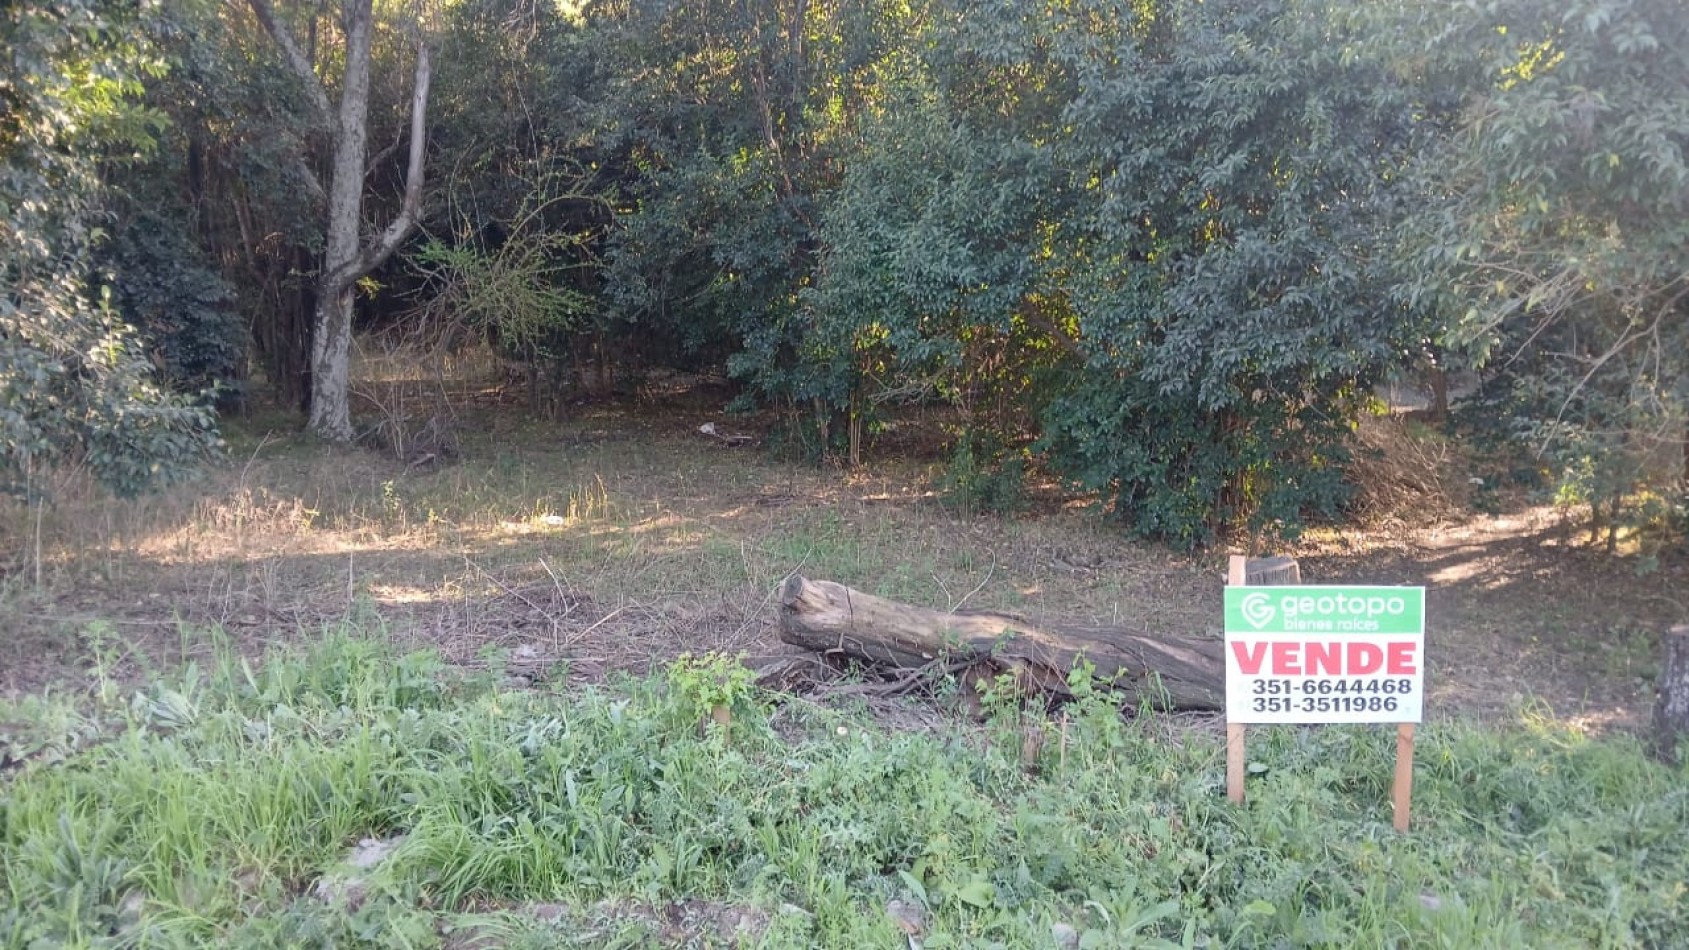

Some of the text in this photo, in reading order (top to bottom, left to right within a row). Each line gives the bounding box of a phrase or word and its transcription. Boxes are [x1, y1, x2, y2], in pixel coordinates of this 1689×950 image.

[1281, 592, 1404, 617] geotopo
[1284, 617, 1332, 631] bienes
[1231, 641, 1416, 675] VENDE
[1252, 679, 1412, 694] 351-6644468
[1252, 697, 1398, 712] 351-3511986
